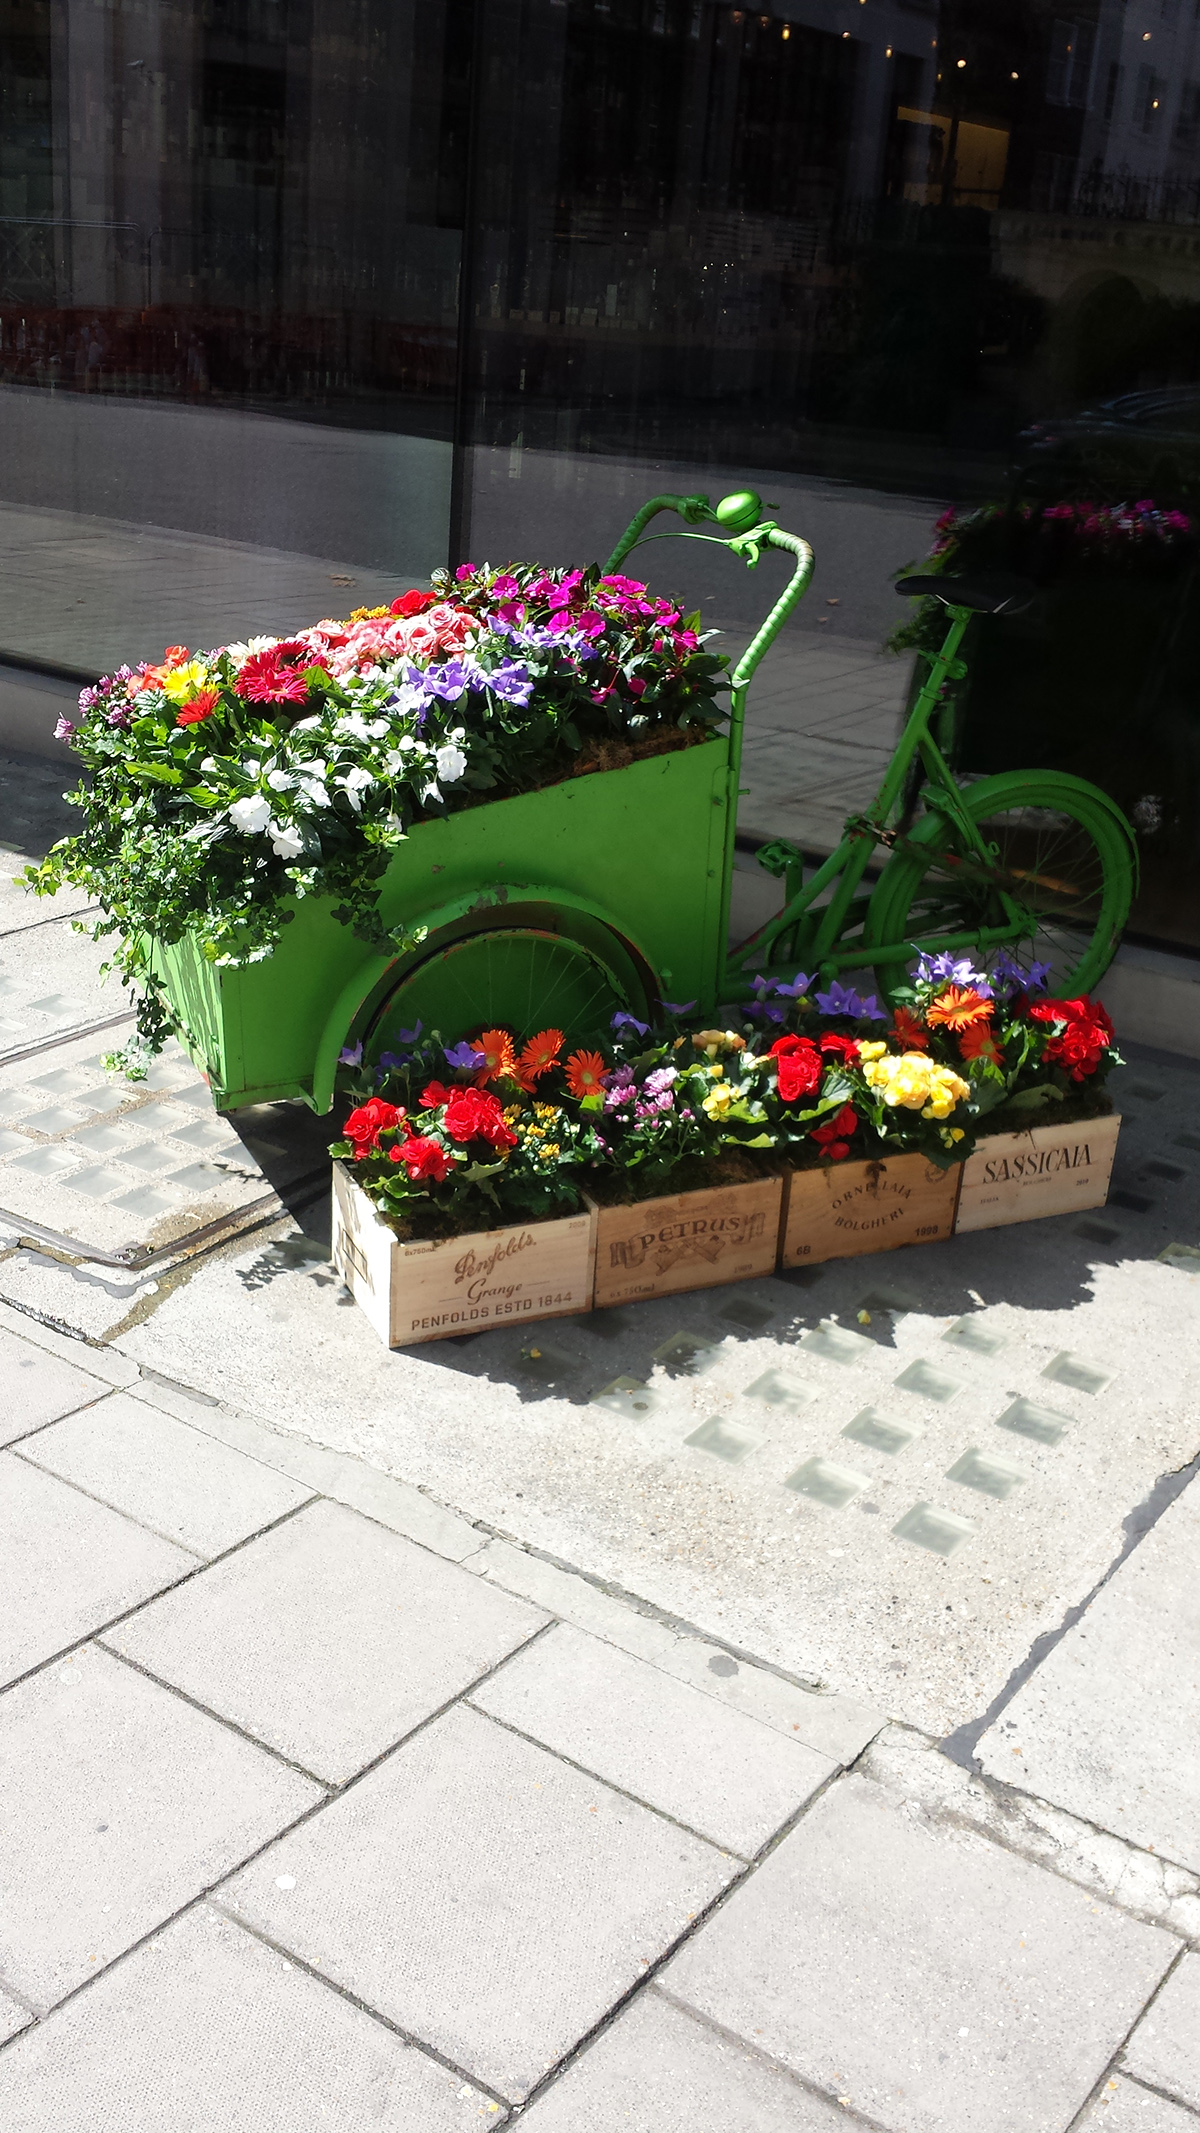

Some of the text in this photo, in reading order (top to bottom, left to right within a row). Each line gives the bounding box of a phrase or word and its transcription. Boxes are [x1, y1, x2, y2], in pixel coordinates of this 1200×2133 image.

[982, 1144, 1093, 1184] SASSICAIA
[832, 1181, 913, 1209] ORNELAIA
[638, 1216, 742, 1250] PETRUS
[834, 1207, 905, 1231] BOLGHERI
[467, 1277, 523, 1305] Grange
[411, 1291, 573, 1331] PENFOLDS ESTD 1844
